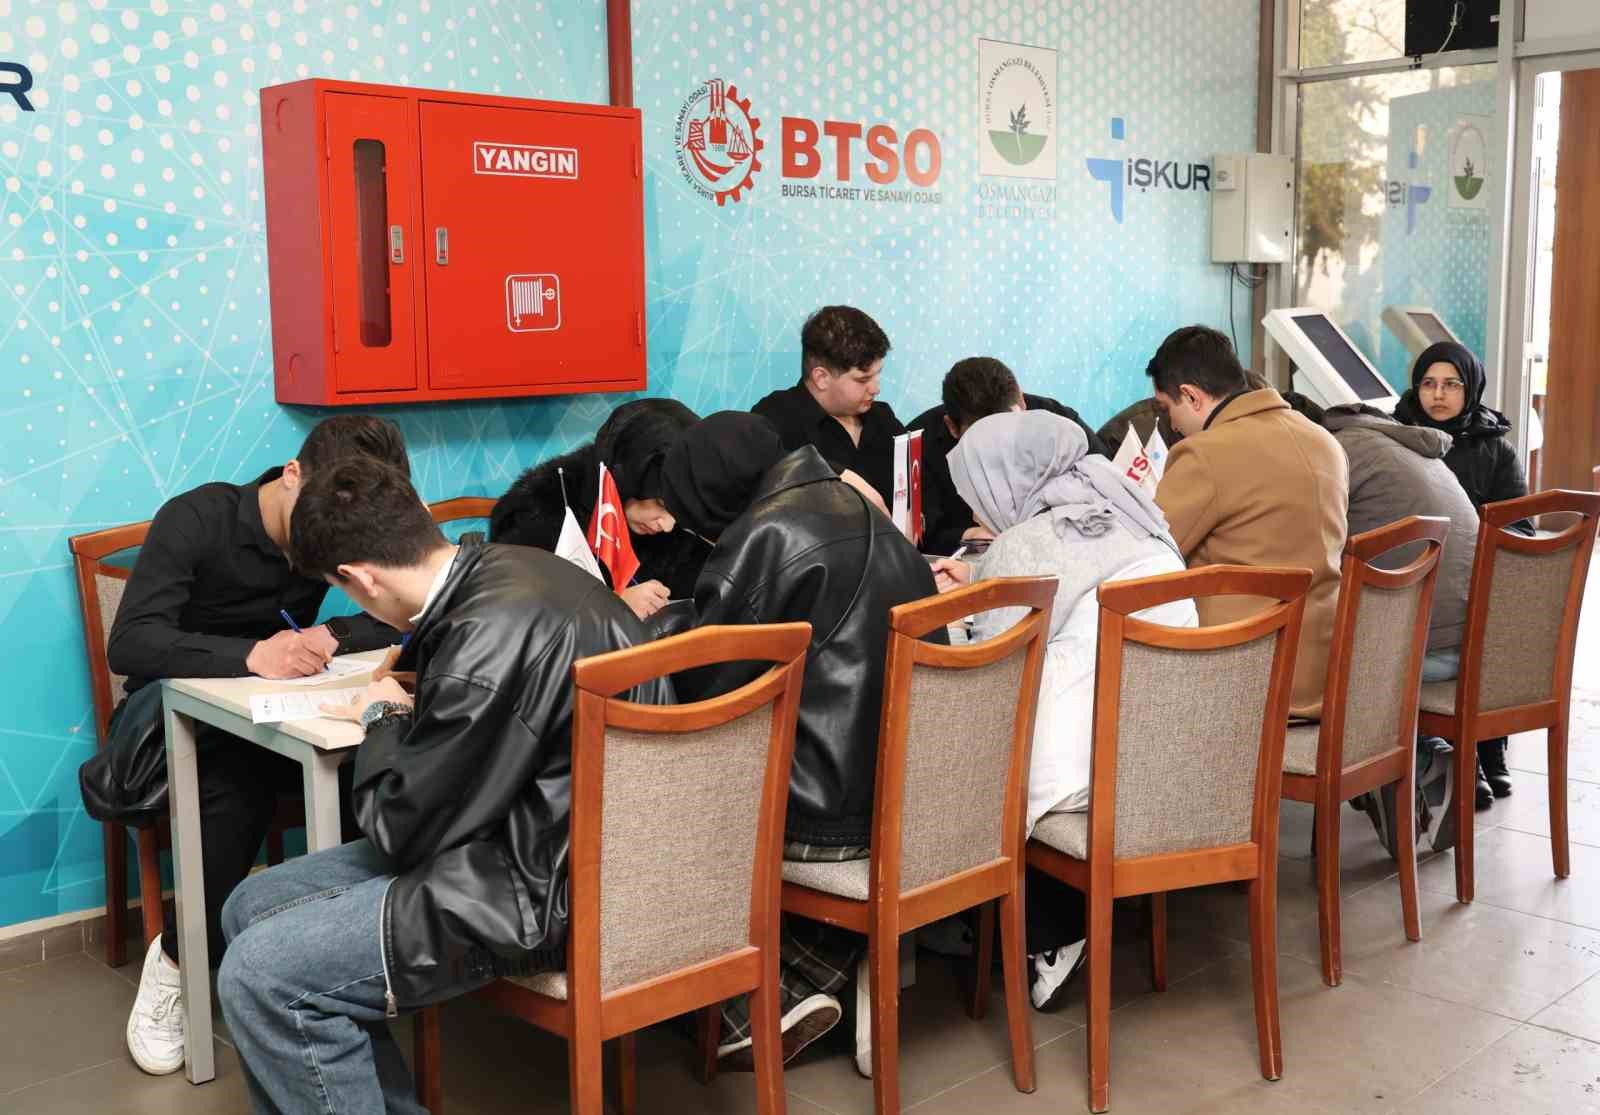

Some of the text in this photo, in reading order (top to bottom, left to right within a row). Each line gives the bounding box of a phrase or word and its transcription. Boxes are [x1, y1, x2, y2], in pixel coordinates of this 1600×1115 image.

[479, 147, 574, 174] YANGIN
[781, 116, 942, 187] BTSO
[781, 184, 816, 198] BURSA
[819, 183, 860, 200] TİCARET
[863, 187, 876, 201] VE
